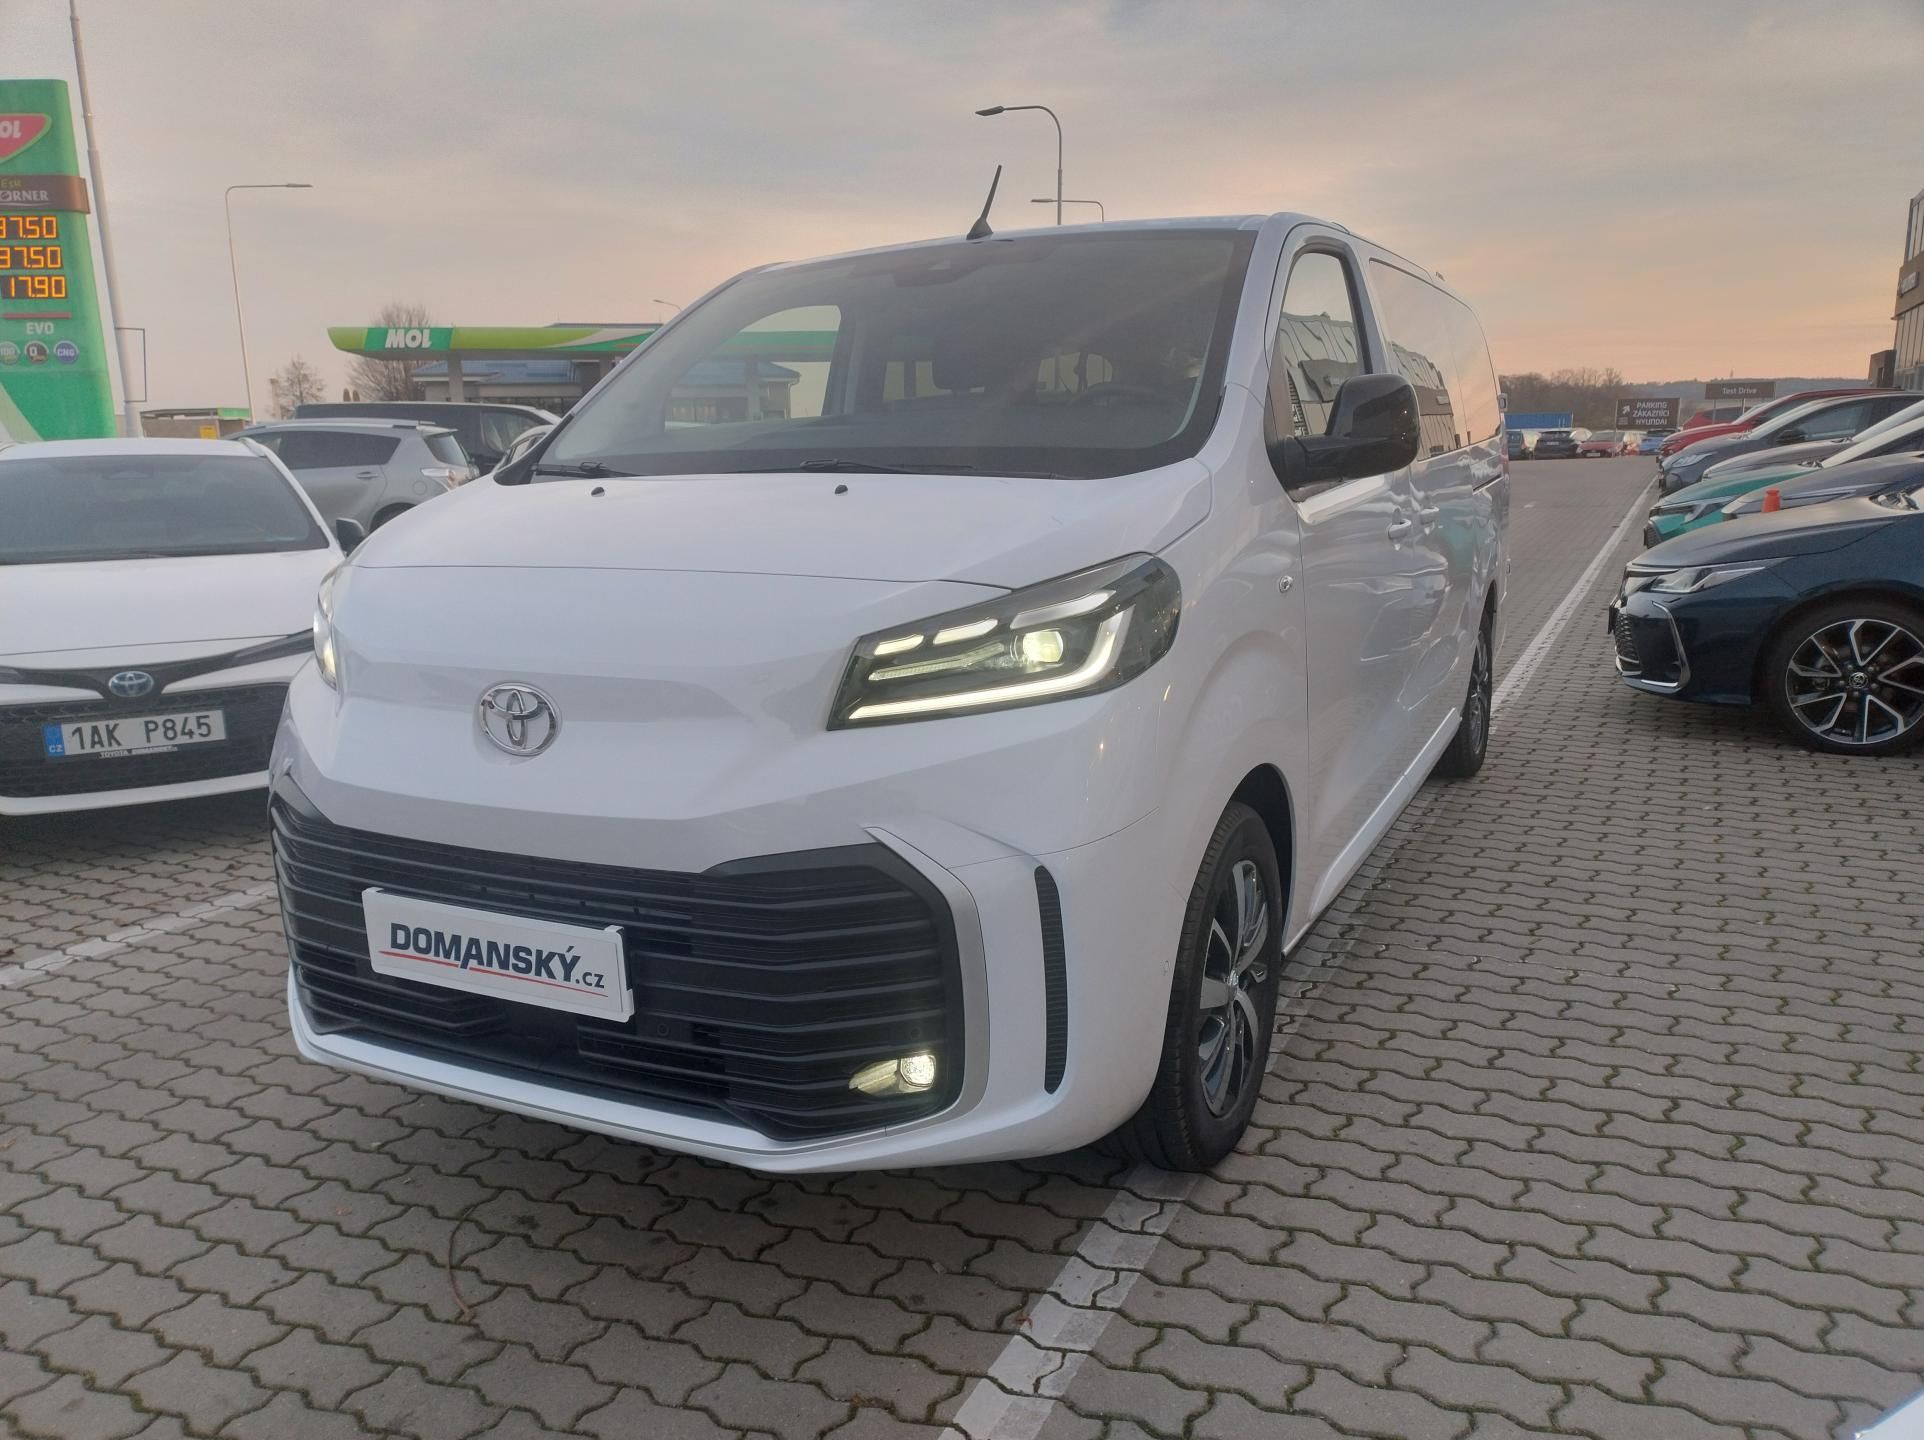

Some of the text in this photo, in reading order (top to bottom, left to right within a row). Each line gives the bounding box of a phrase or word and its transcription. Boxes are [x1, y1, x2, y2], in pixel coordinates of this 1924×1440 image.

[0, 120, 22, 138] OL
[11, 275, 66, 298] 17.90
[26, 322, 55, 335] EVO
[385, 328, 432, 348] MOL
[1722, 387, 1757, 395] Test Drive
[1636, 401, 1667, 409] PARKING
[1635, 418, 1667, 426] HYUNDAI
[72, 723, 122, 750] 1AK
[143, 714, 212, 744] P845
[49, 745, 64, 753] CZ
